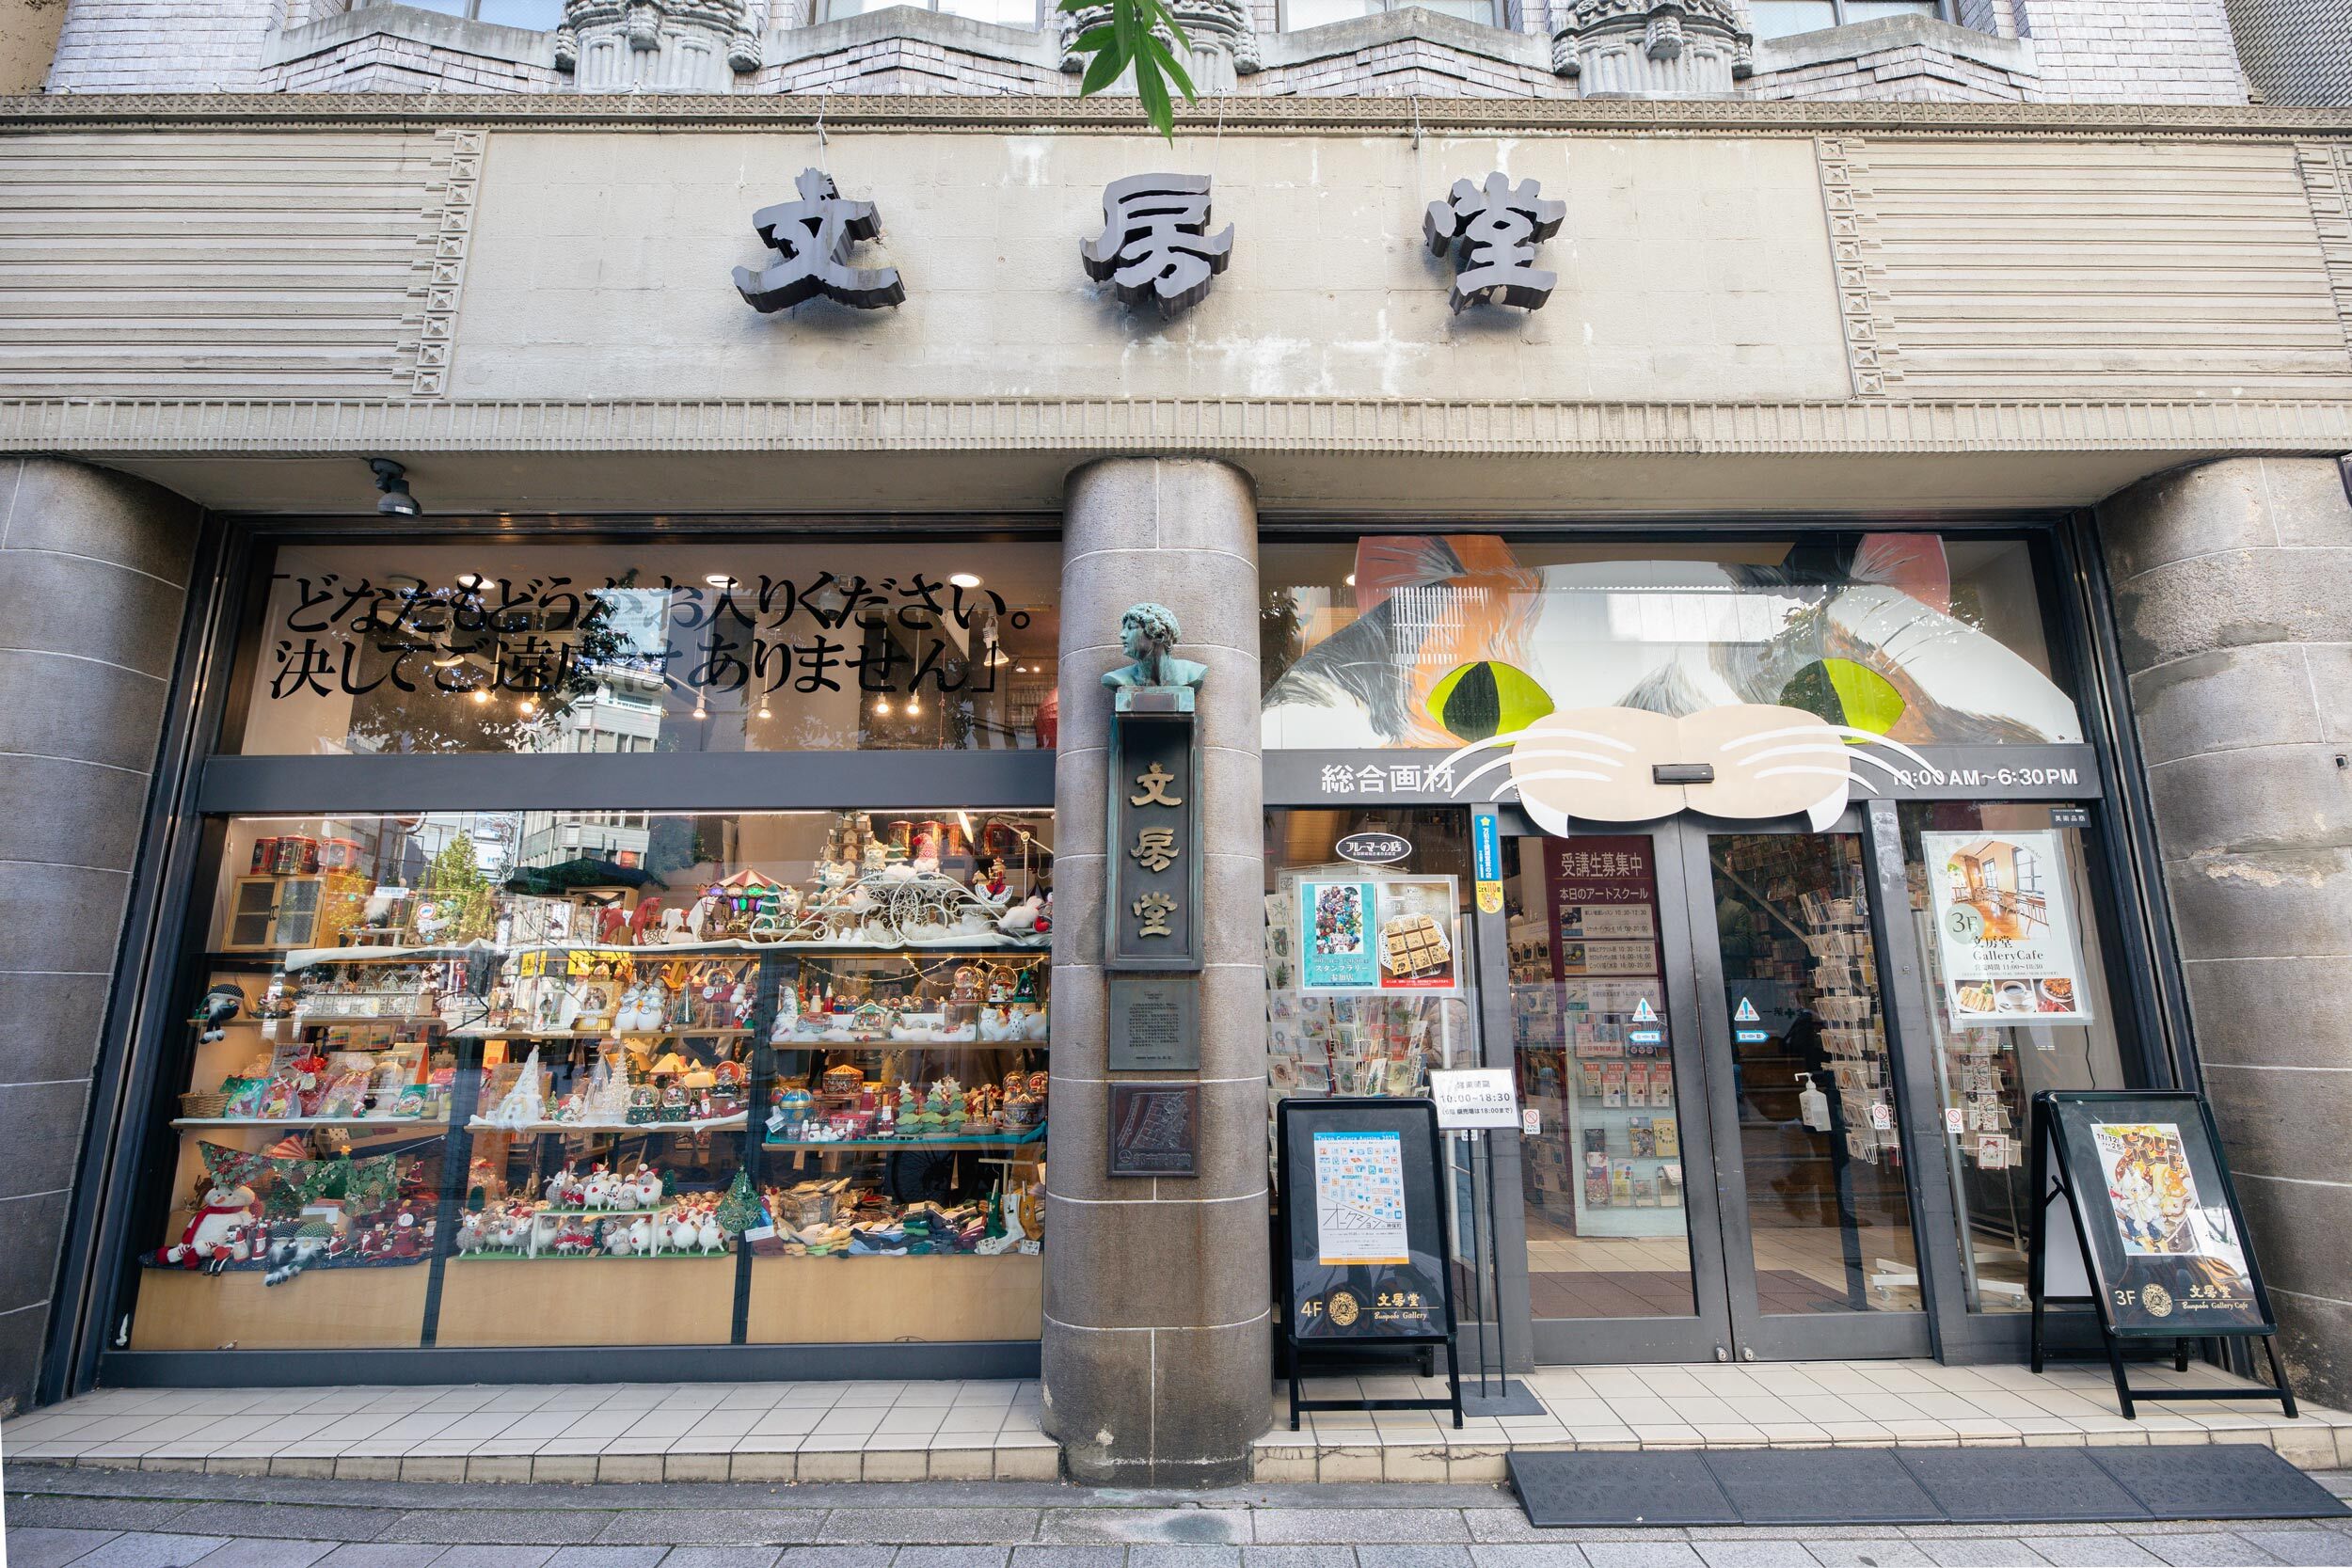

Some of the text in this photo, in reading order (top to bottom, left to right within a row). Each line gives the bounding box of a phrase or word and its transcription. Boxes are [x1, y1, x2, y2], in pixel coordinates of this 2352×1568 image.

[732, 166, 1568, 320] 文房堂
[1321, 764, 1455, 794] 総合画材
[1129, 761, 1183, 938] 文房堂
[1562, 852, 1643, 877] 受講生募集中
[1560, 888, 1648, 900] 本日のアートスクール
[2115, 1291, 2136, 1306] 3F
[2211, 1302, 2234, 1310] Gallery
[2234, 1302, 2249, 1310] Cafe
[1301, 1301, 1323, 1317] 4F
[1402, 1311, 1427, 1321] Gallery
